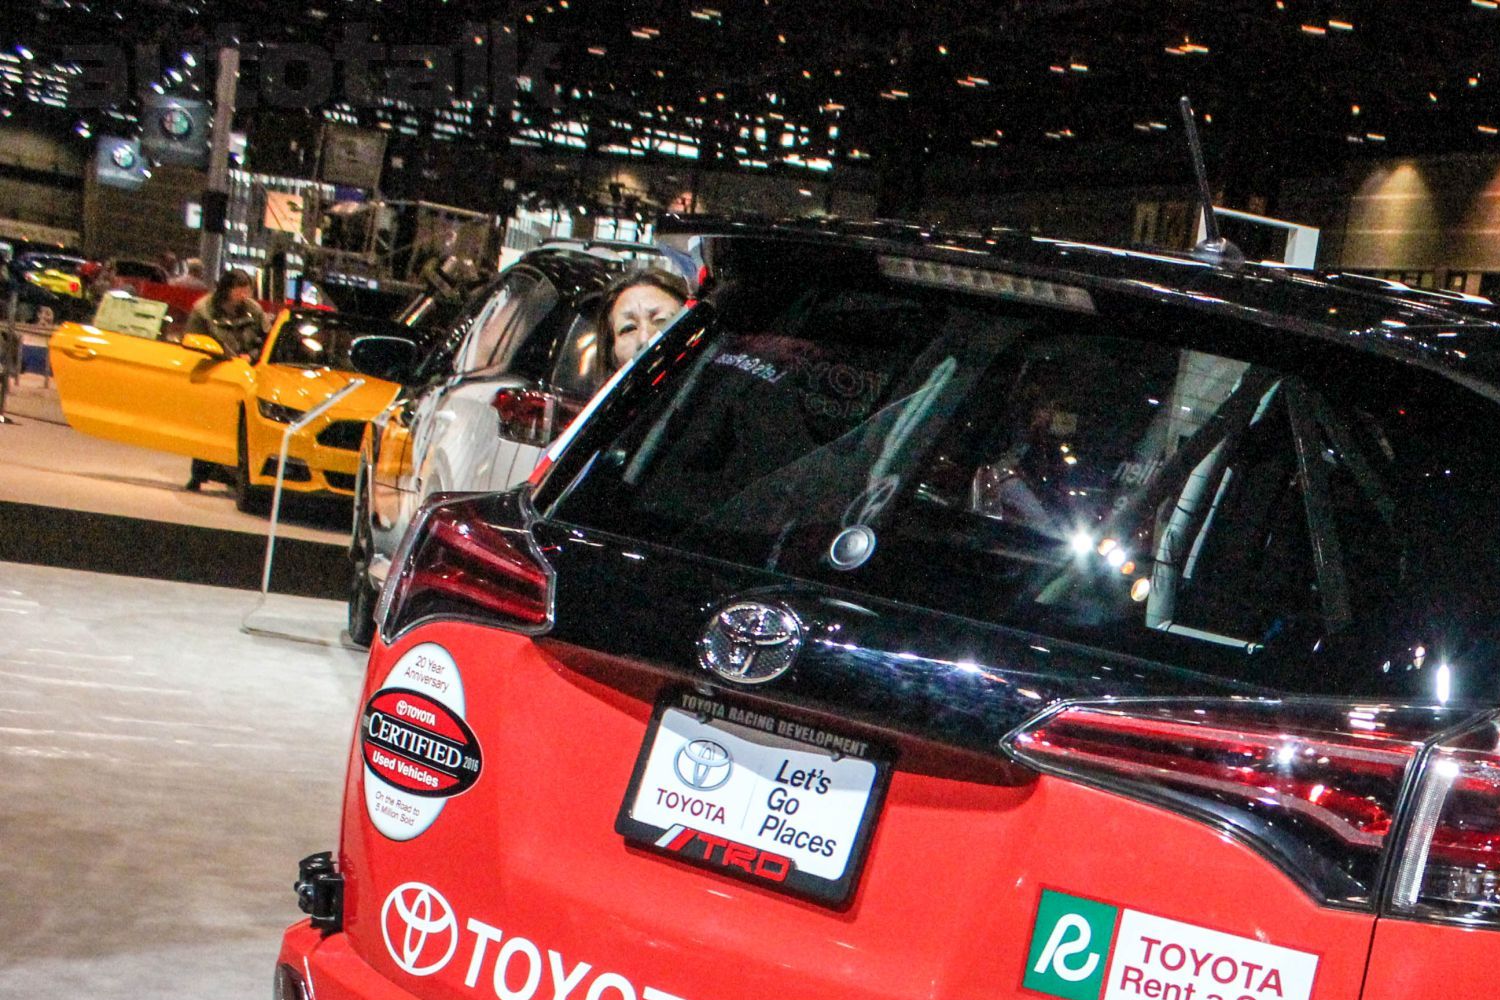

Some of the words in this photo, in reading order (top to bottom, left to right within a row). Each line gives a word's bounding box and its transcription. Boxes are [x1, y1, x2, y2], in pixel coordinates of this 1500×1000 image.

[404, 667, 449, 693] Anniversary
[415, 655, 427, 668] 20
[427, 658, 446, 675] Year
[406, 704, 436, 727] TOYOTA
[681, 694, 725, 719] TOYOTA
[728, 704, 774, 731] RACING
[777, 720, 869, 757] DEVELOPMENT
[368, 711, 463, 769] CERTIFIED
[372, 750, 397, 771] Used
[397, 759, 439, 788] Vehicles
[774, 759, 832, 795] Let's
[655, 788, 726, 825] TOYOTA
[766, 787, 800, 815] Go
[757, 814, 838, 857] Places
[697, 830, 792, 882] TRD
[1139, 935, 1284, 998] TOYOTA
